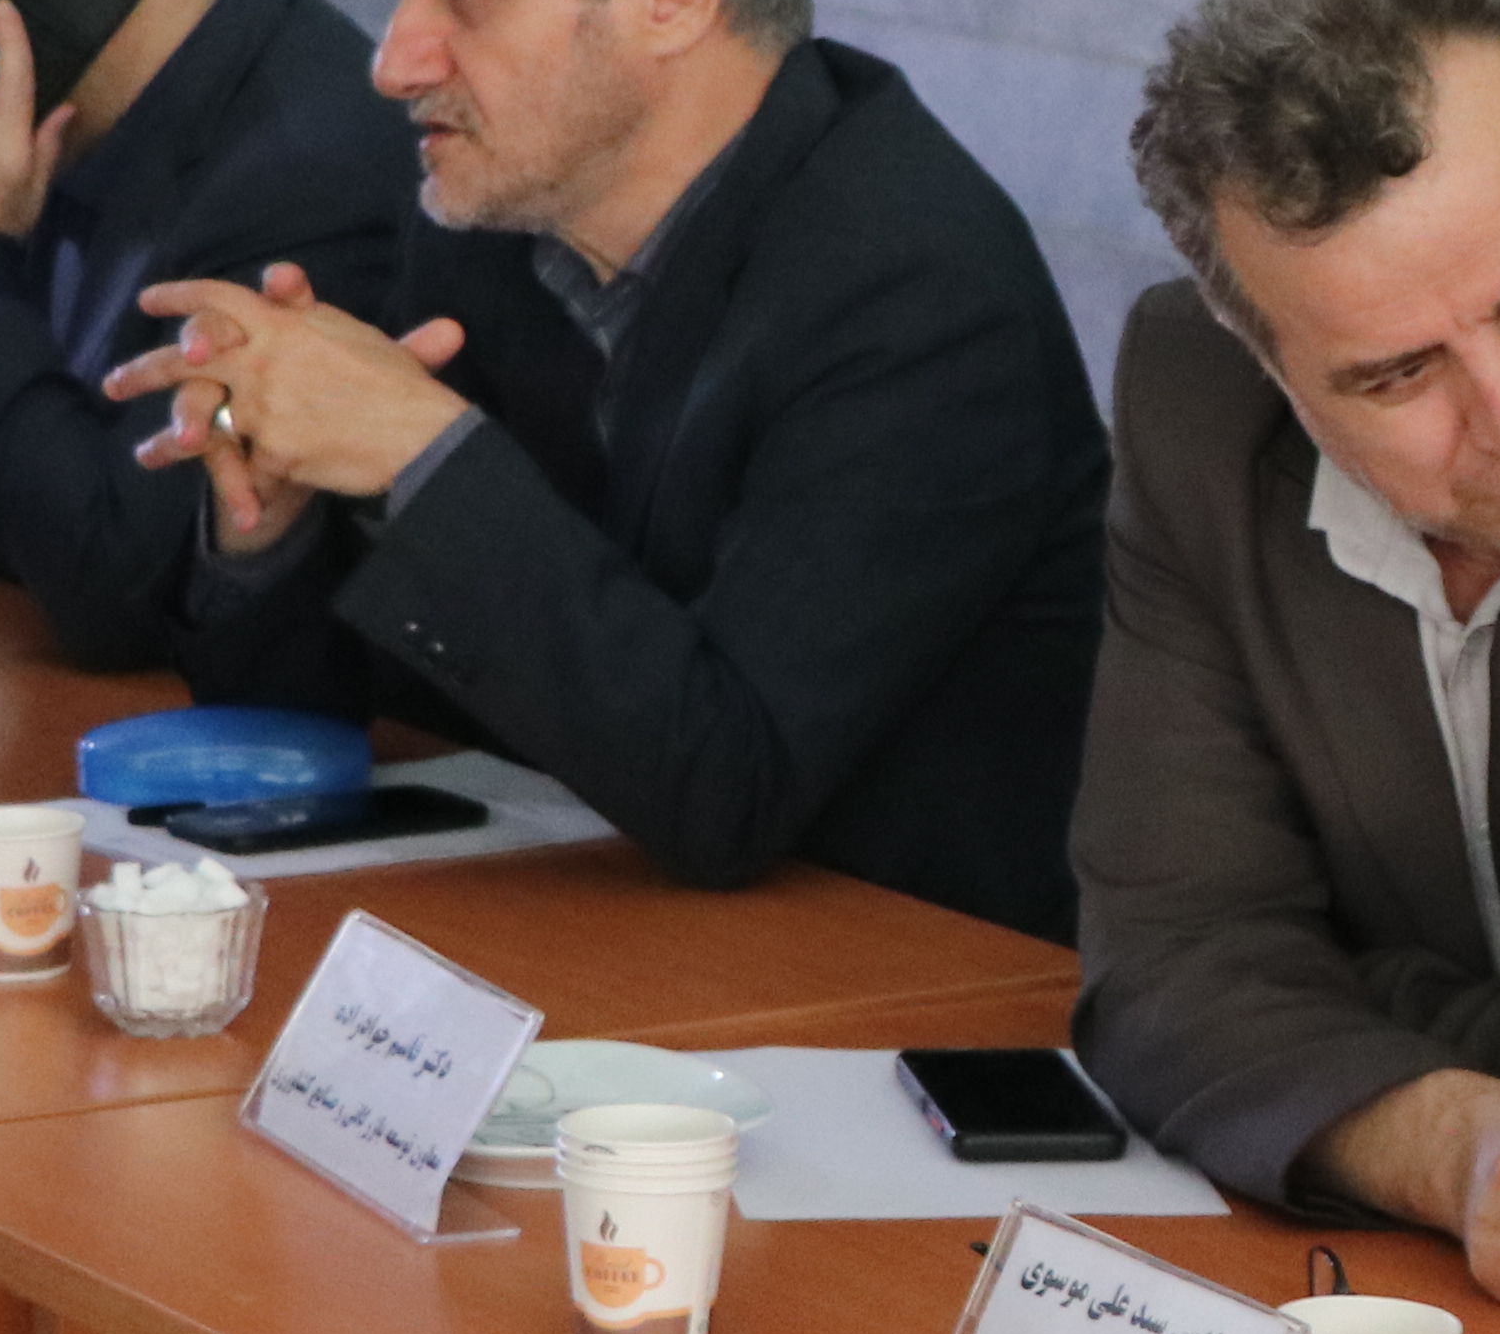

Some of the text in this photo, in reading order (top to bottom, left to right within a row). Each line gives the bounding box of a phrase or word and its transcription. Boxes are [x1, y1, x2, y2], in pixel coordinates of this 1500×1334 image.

[411, 1048, 452, 1079] دکتر
[1020, 1261, 1090, 1308] موسوی
[1087, 1283, 1131, 1320] علی
